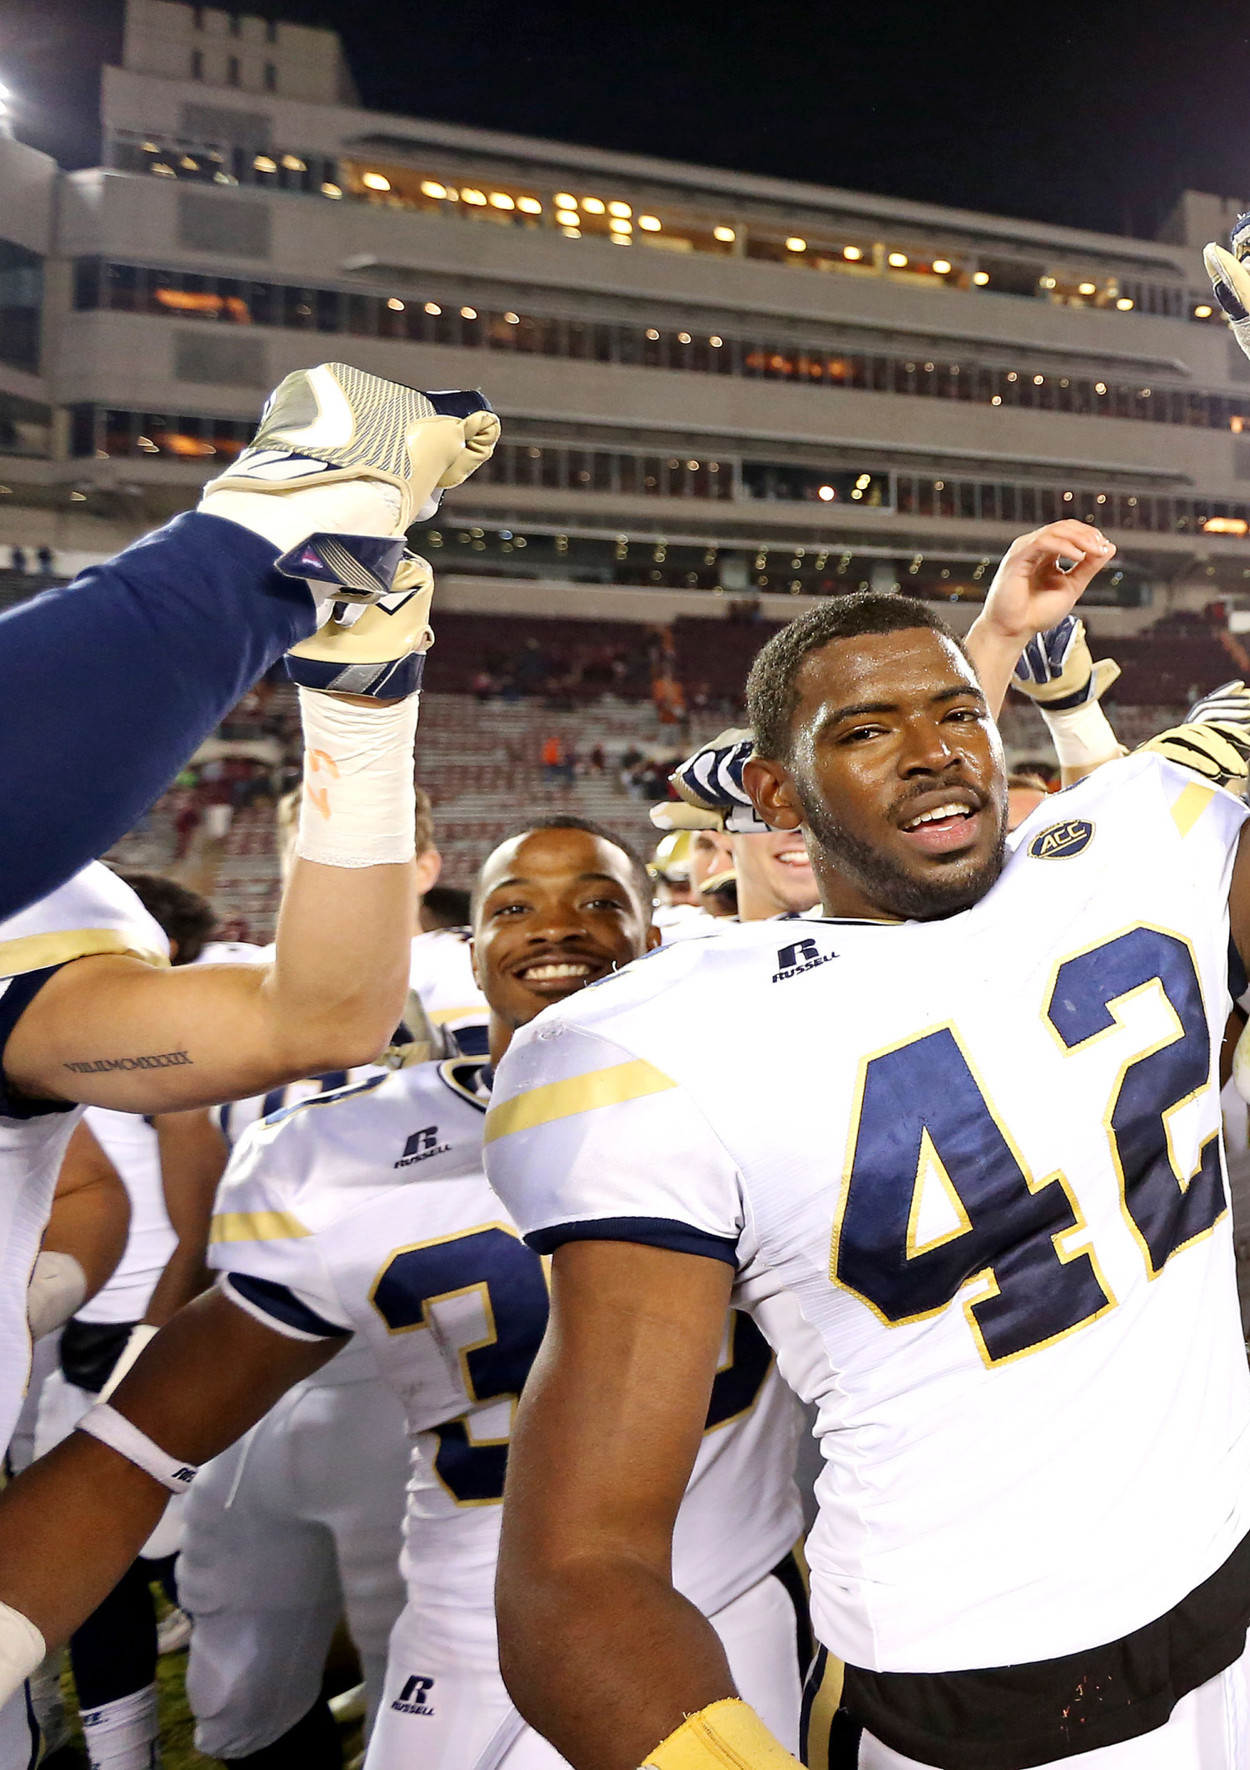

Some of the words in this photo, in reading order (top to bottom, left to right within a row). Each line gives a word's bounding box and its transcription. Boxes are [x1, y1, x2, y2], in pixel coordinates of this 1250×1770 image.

[1041, 821, 1086, 854] ACC
[772, 951, 841, 983] RUSSELL
[394, 1144, 453, 1169] RUSSELL
[829, 919, 1229, 1370] 42
[391, 1700, 435, 1716] RUSSELL
